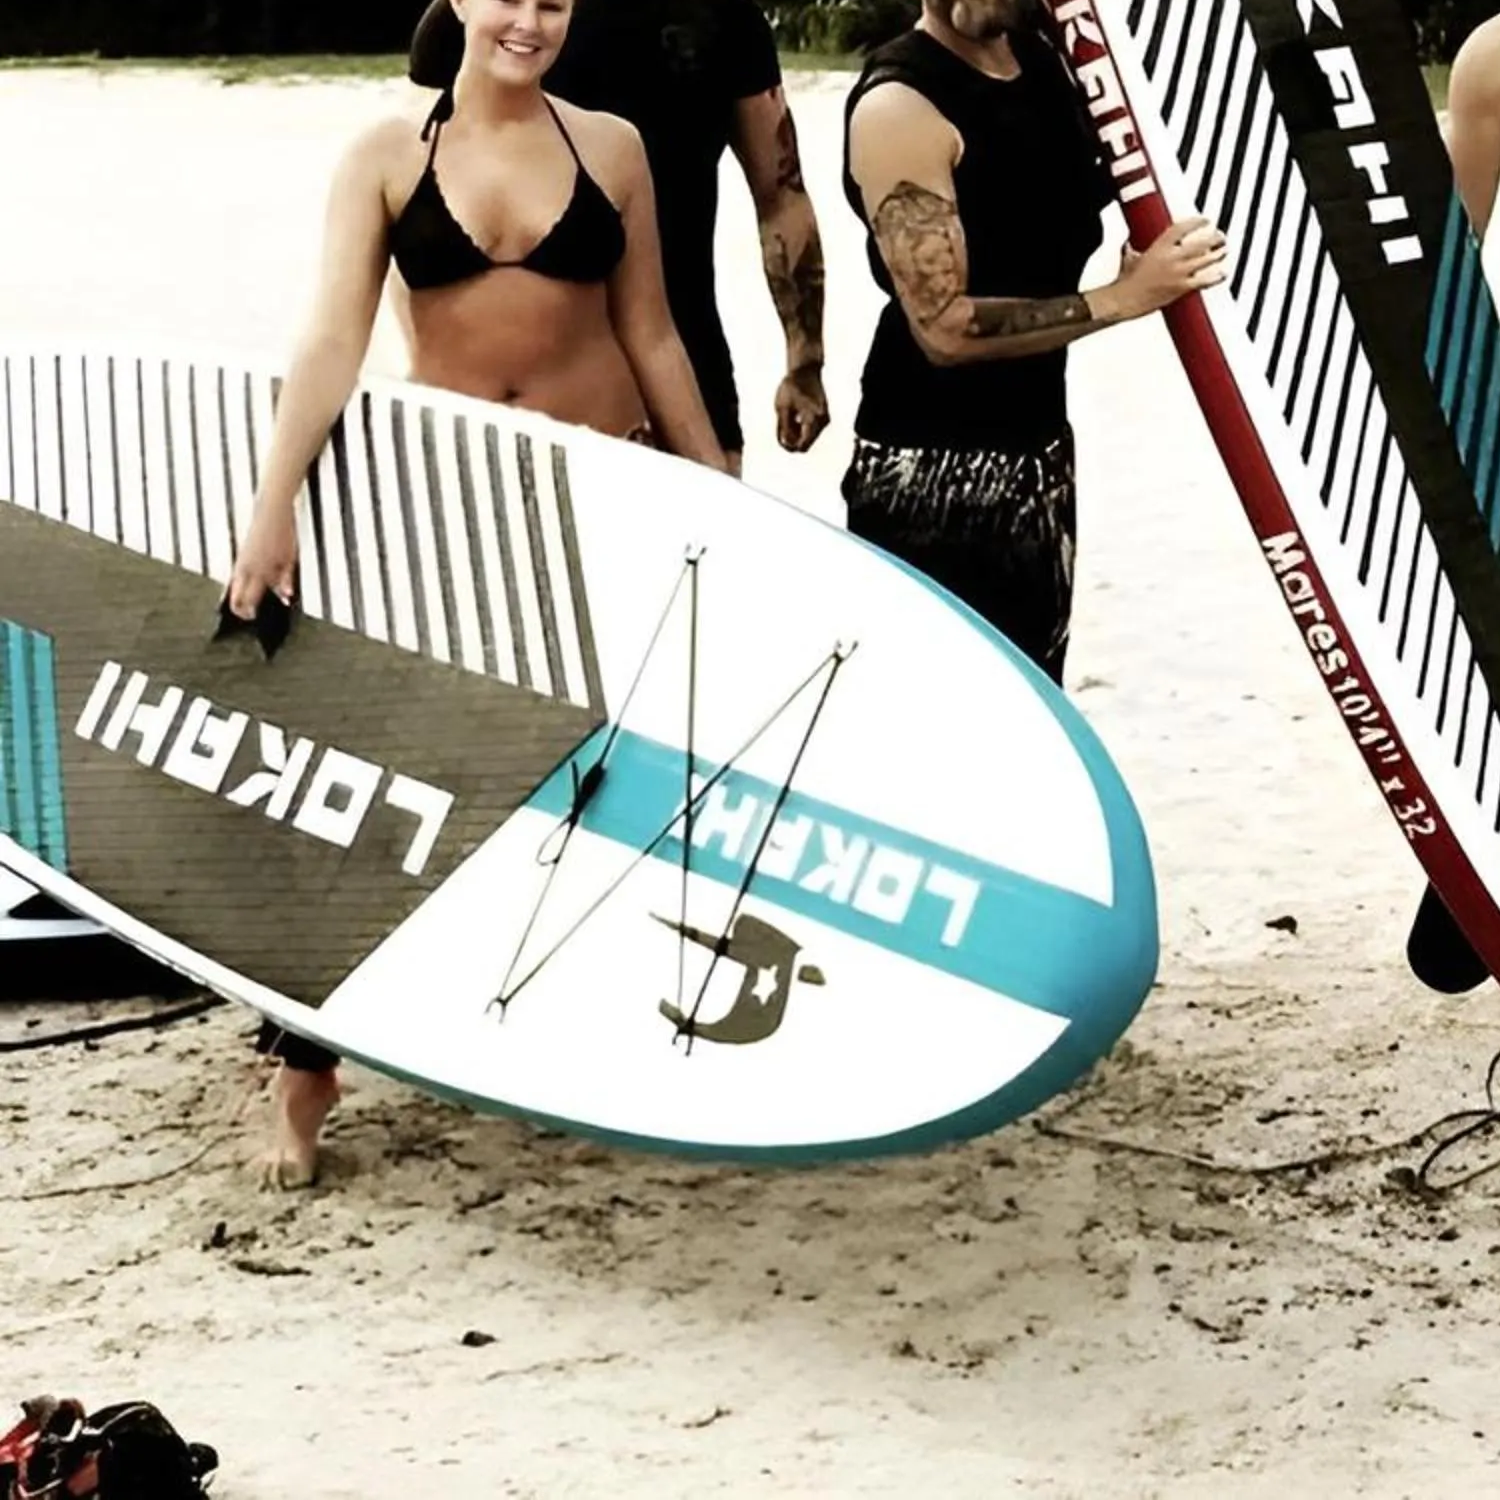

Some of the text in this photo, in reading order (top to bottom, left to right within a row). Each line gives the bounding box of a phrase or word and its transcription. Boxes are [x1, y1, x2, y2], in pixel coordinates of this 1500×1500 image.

[74, 660, 455, 876] LOKAHI
[1262, 531, 1348, 676] Mares
[1397, 798, 1437, 840] 32
[668, 770, 984, 948] LOKAHI
